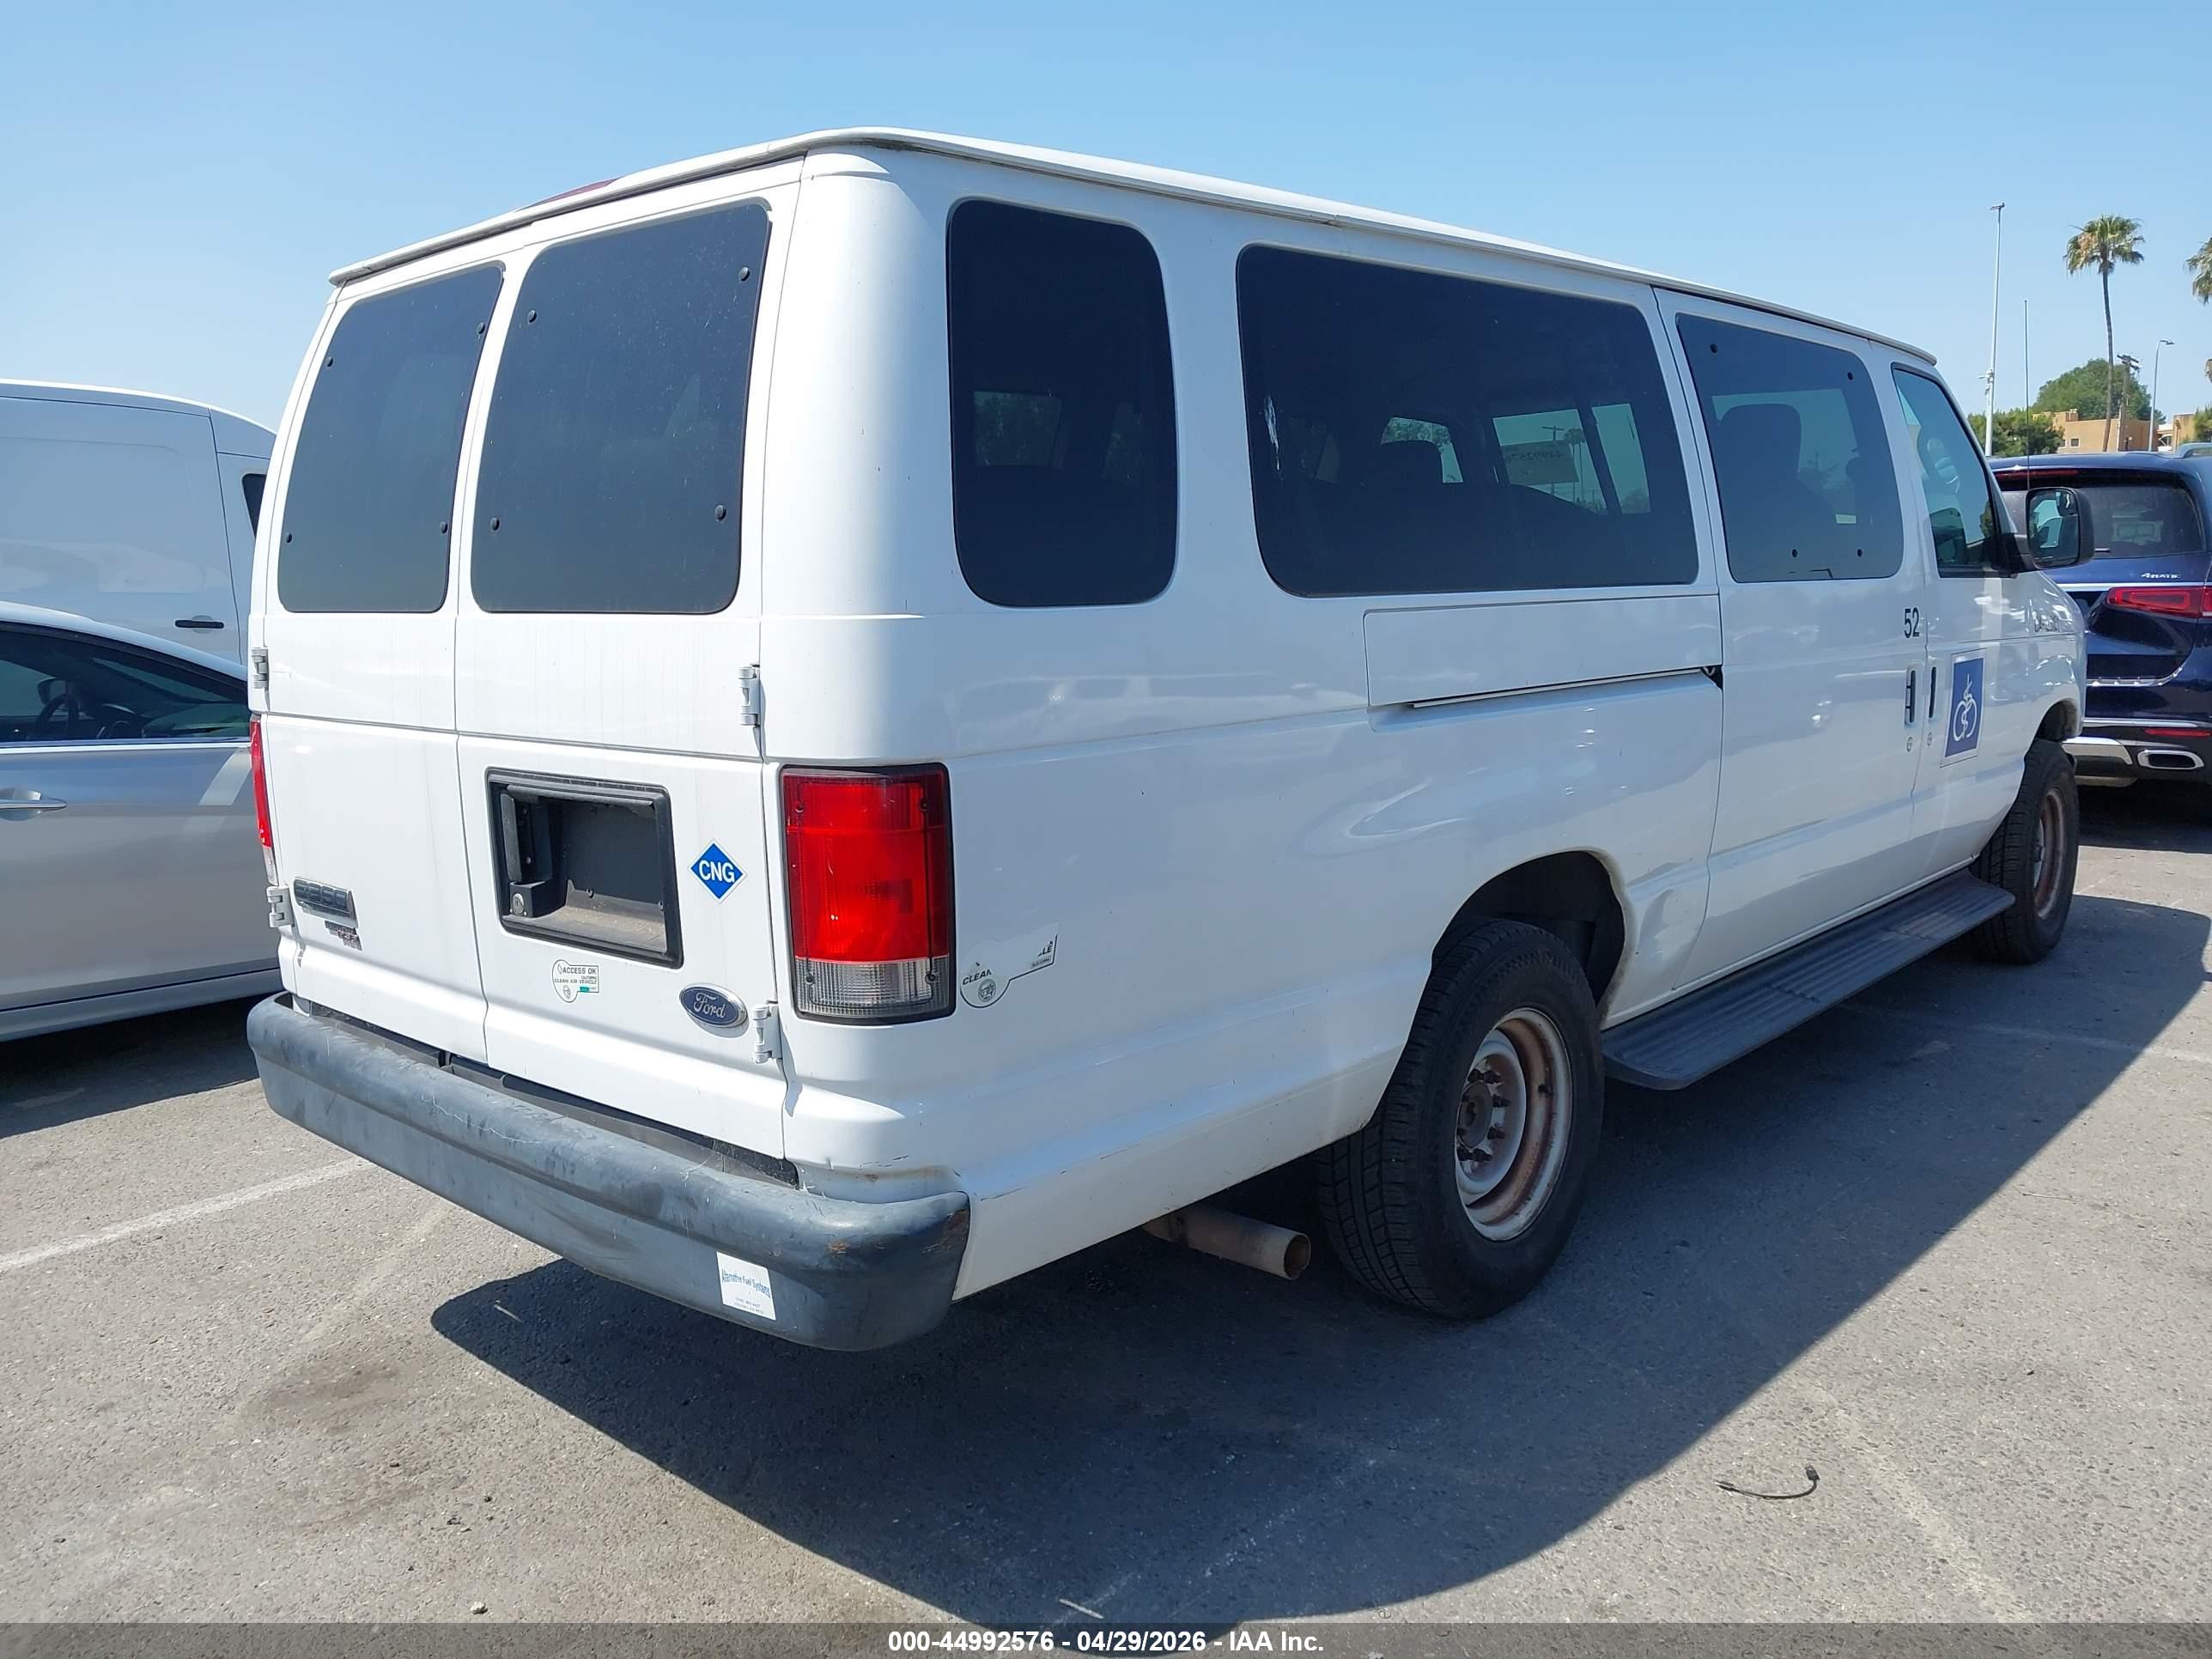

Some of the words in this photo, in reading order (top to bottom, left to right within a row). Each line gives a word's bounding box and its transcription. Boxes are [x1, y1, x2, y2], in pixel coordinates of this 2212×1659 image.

[1904, 607, 1920, 638] 52
[698, 860, 736, 883] CNG
[693, 992, 726, 1018] Ford
[743, 1275, 752, 1286] Fuel
